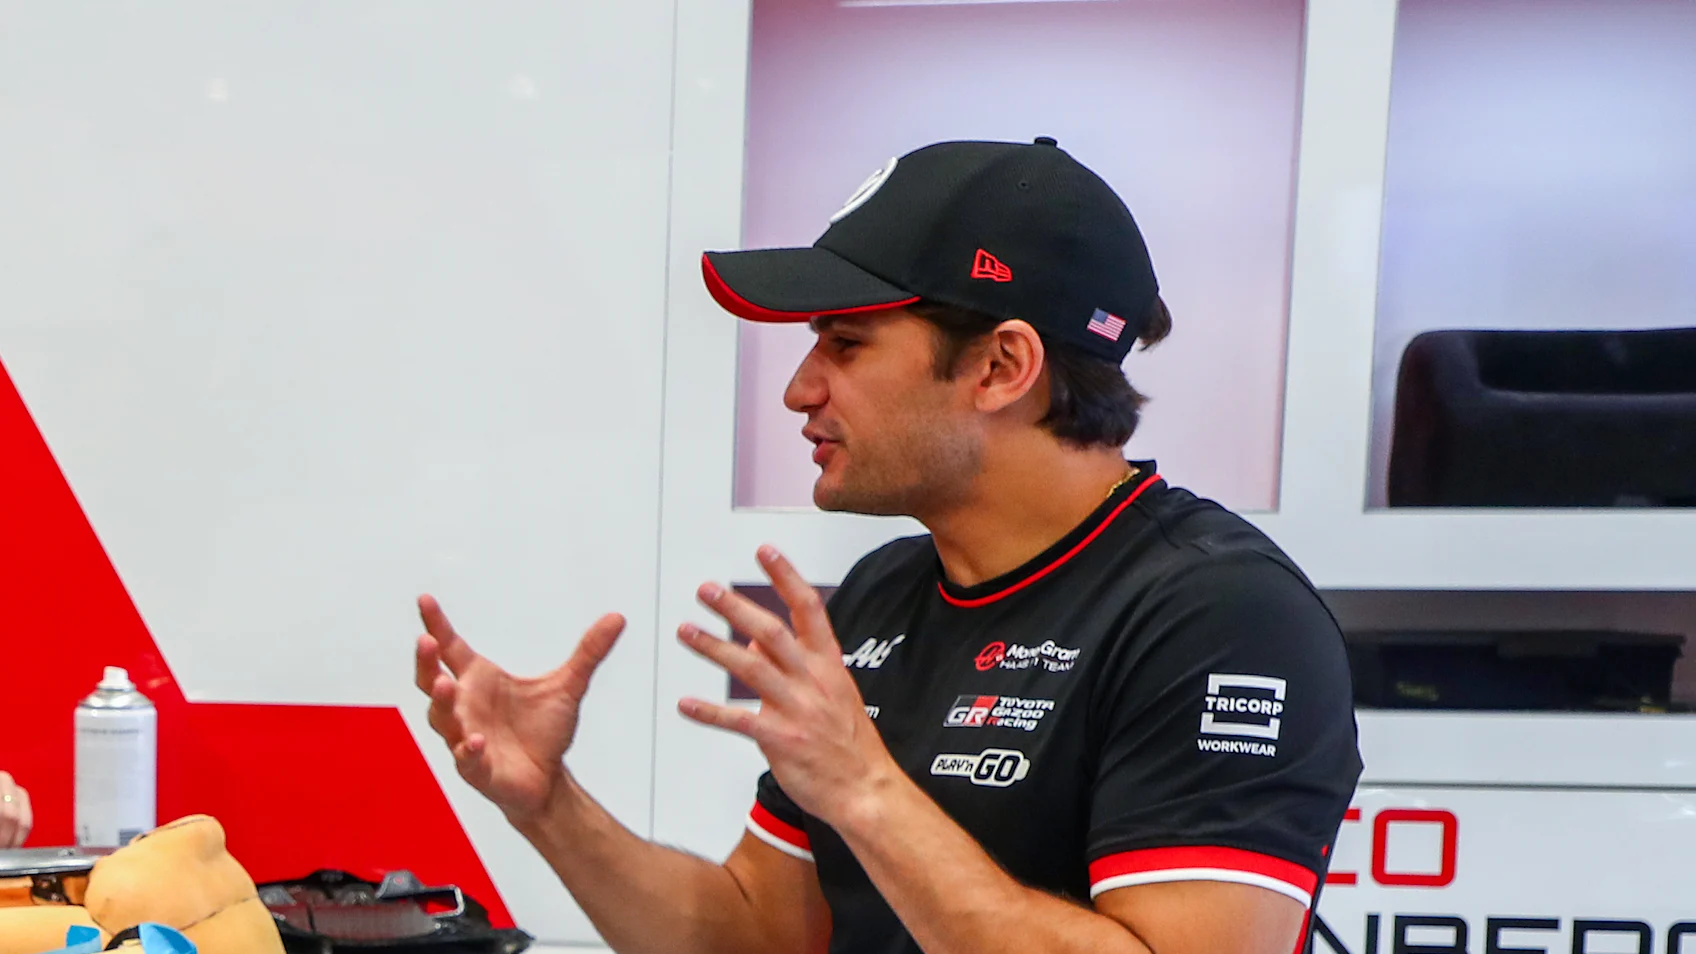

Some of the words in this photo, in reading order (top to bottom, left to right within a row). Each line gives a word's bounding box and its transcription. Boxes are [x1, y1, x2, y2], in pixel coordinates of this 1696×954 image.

[991, 705, 1045, 719] GAZOO
[999, 696, 1055, 711] TOYOTA
[1205, 696, 1284, 715] TRICORP
[947, 706, 989, 726] GR
[1197, 738, 1277, 757] WORKWEAR
[974, 753, 1021, 782] GO
